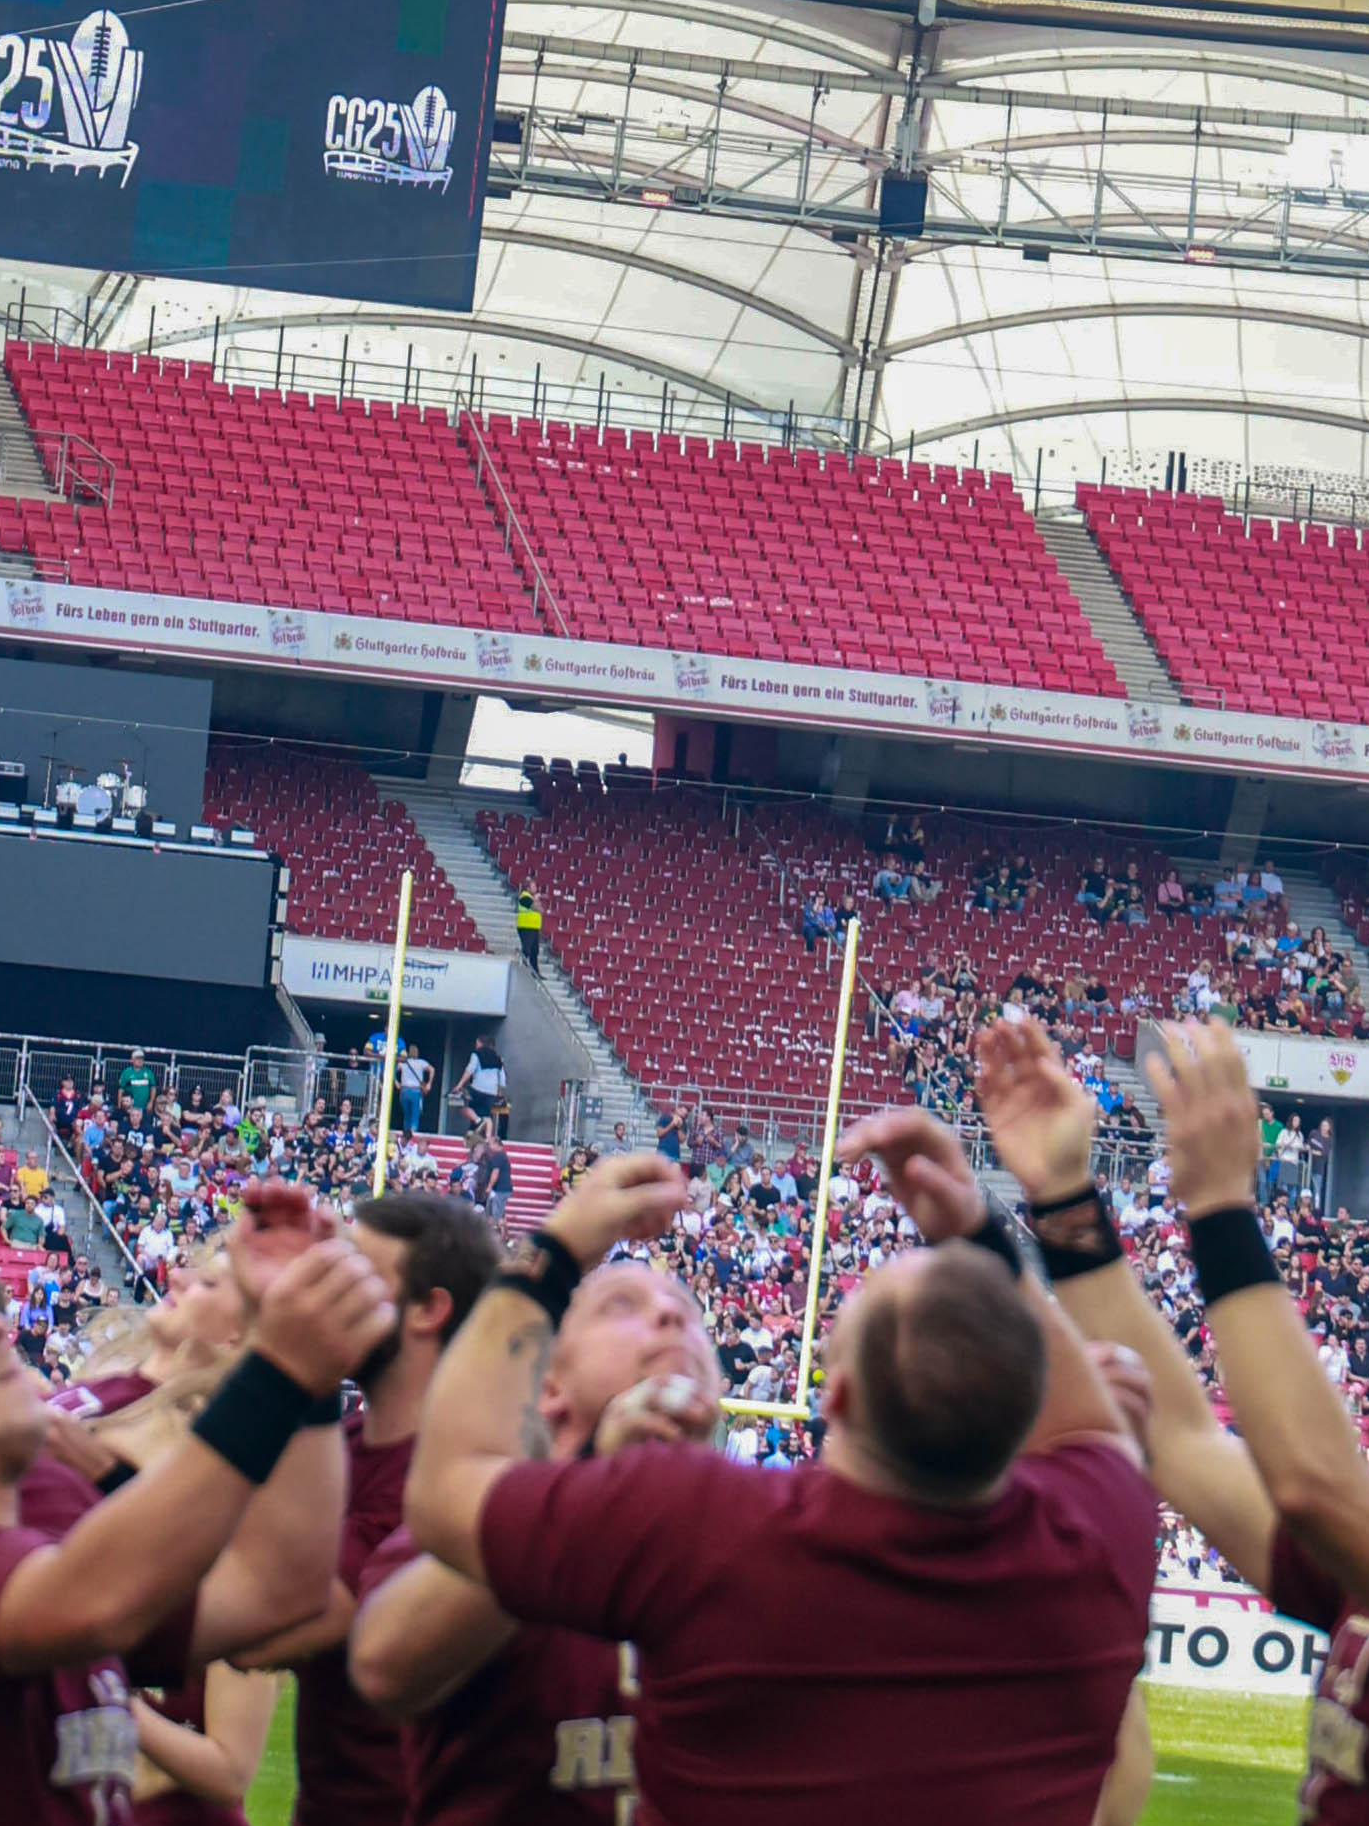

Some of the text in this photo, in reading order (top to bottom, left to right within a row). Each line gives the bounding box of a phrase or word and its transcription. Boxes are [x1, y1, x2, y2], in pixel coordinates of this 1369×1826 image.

[325, 94, 403, 159] CG25
[55, 602, 261, 639] Fürs Leben gern ein Stuttgarter.
[721, 674, 748, 691] Fürs
[751, 676, 789, 695] Leben
[793, 683, 821, 700] gern
[825, 684, 845, 700] ein
[848, 687, 918, 709] Stuttgarter.
[332, 964, 435, 991] MHP Aena
